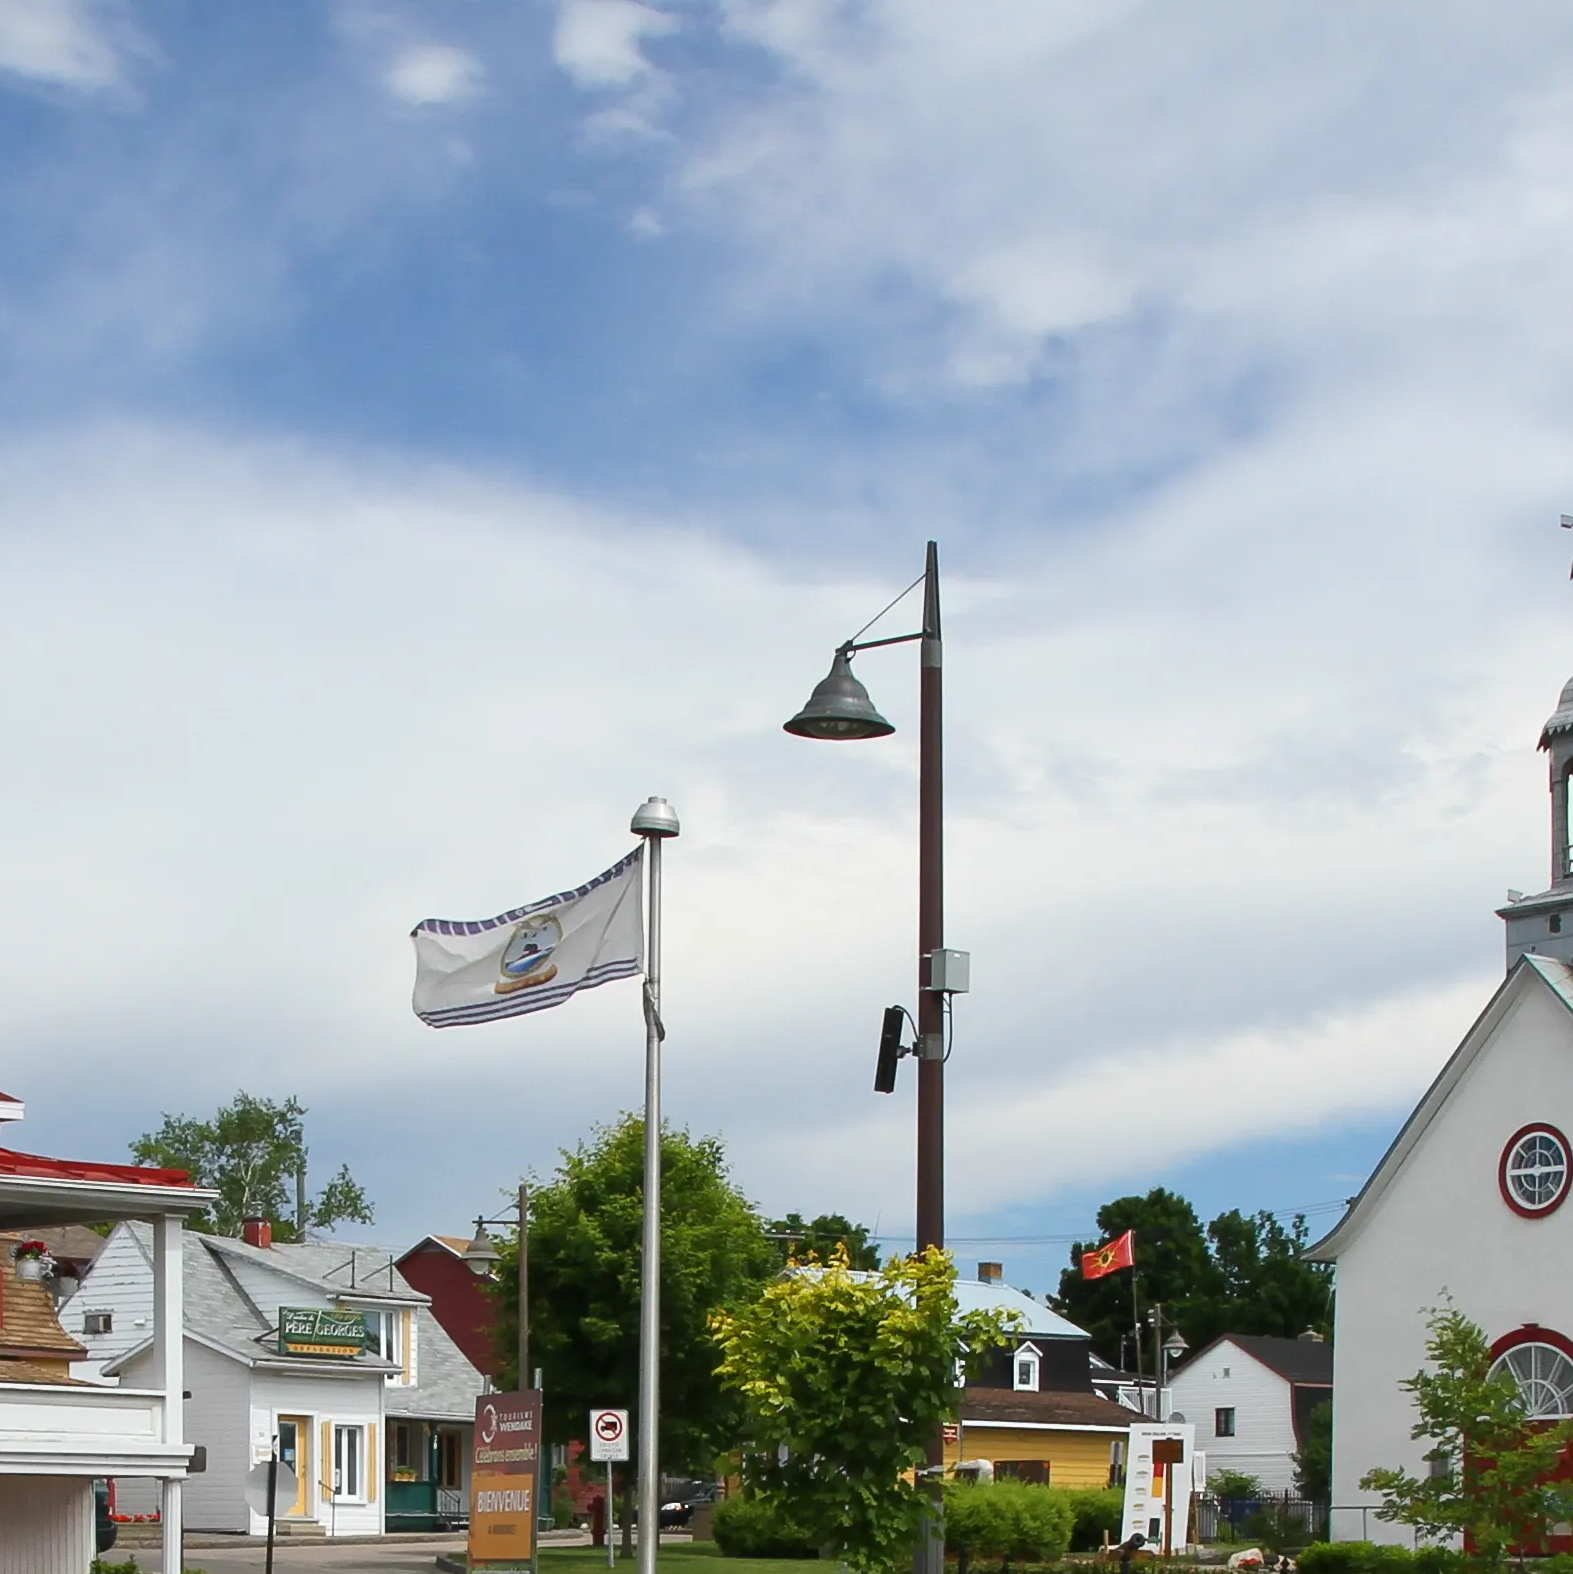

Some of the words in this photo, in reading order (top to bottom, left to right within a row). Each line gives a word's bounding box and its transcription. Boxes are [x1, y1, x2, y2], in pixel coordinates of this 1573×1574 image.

[285, 1321, 313, 1334] PÈRE
[316, 1323, 365, 1337] GEORGES
[499, 1411, 533, 1421] TOURISME
[499, 1420, 533, 1432] WENDAKE
[477, 1489, 530, 1512] BIENVENUE
